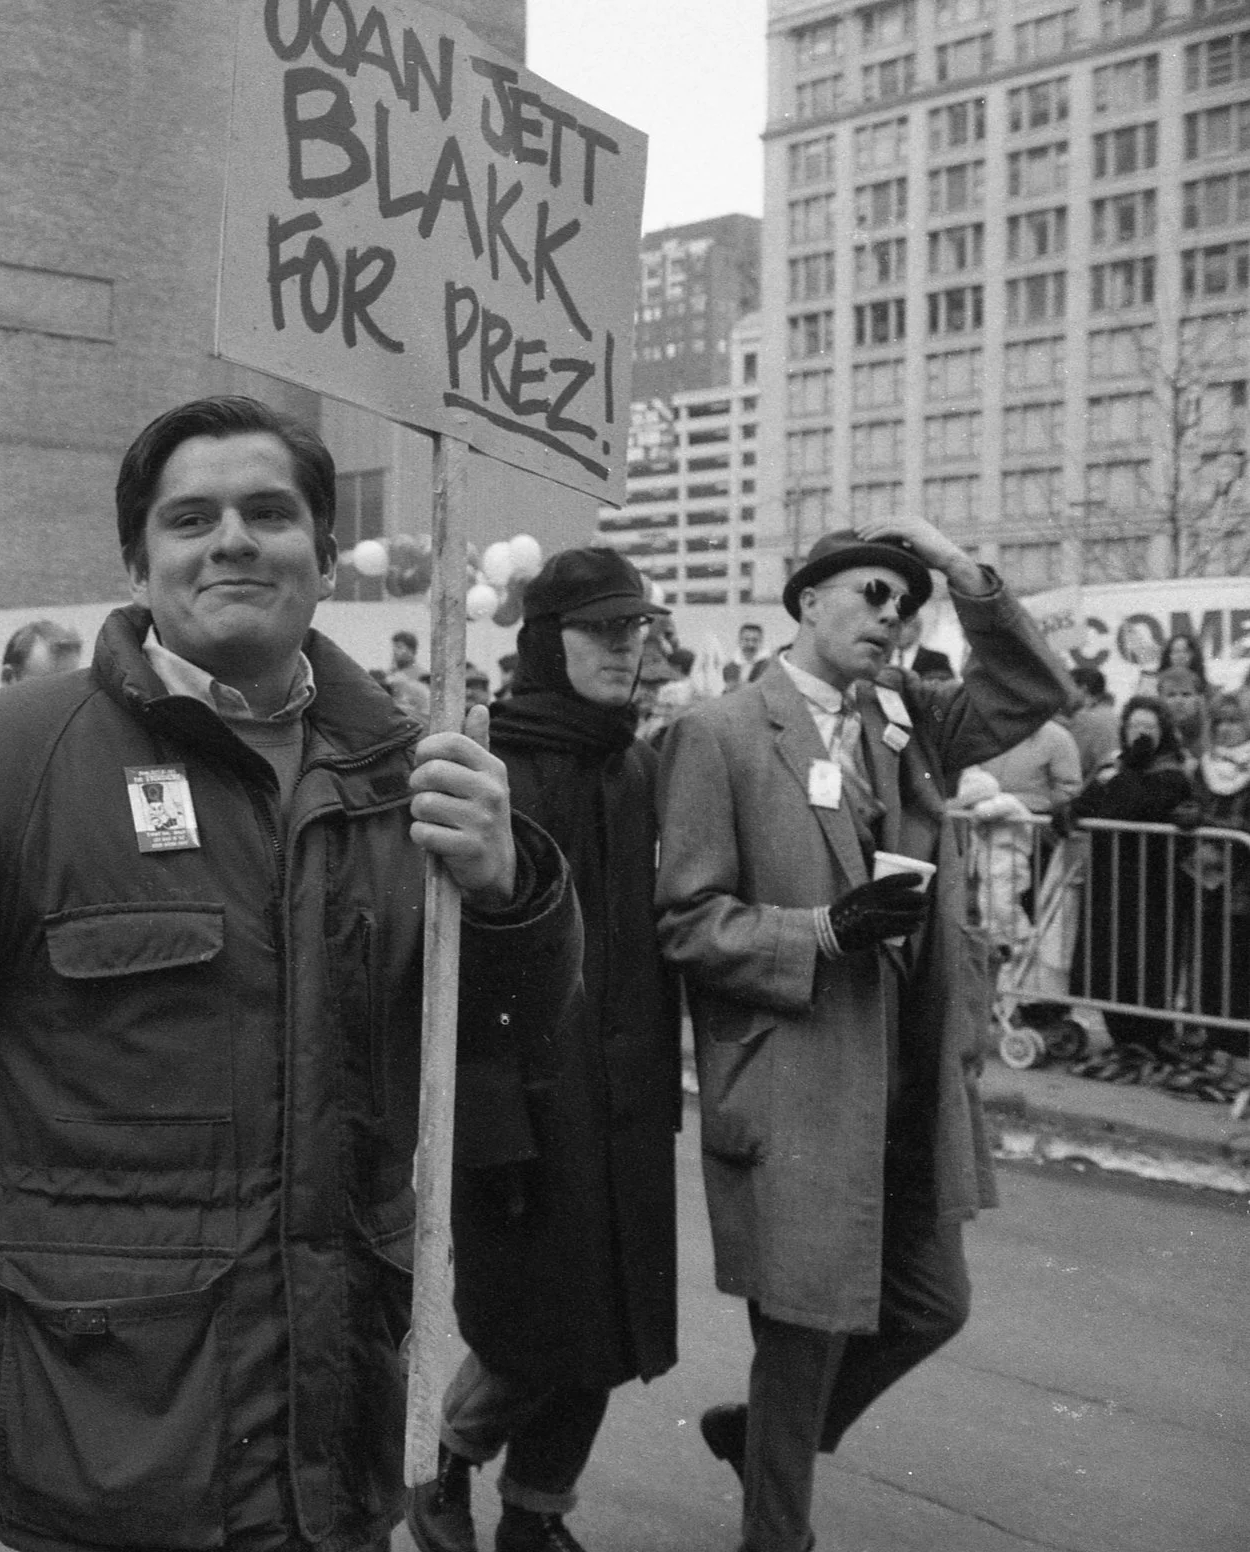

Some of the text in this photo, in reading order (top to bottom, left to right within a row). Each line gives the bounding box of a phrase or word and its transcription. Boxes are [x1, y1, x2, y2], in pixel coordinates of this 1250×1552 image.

[283, 66, 593, 342] BLAKK
[470, 55, 620, 206] JETT
[266, 210, 615, 456] FOR PREZ!
